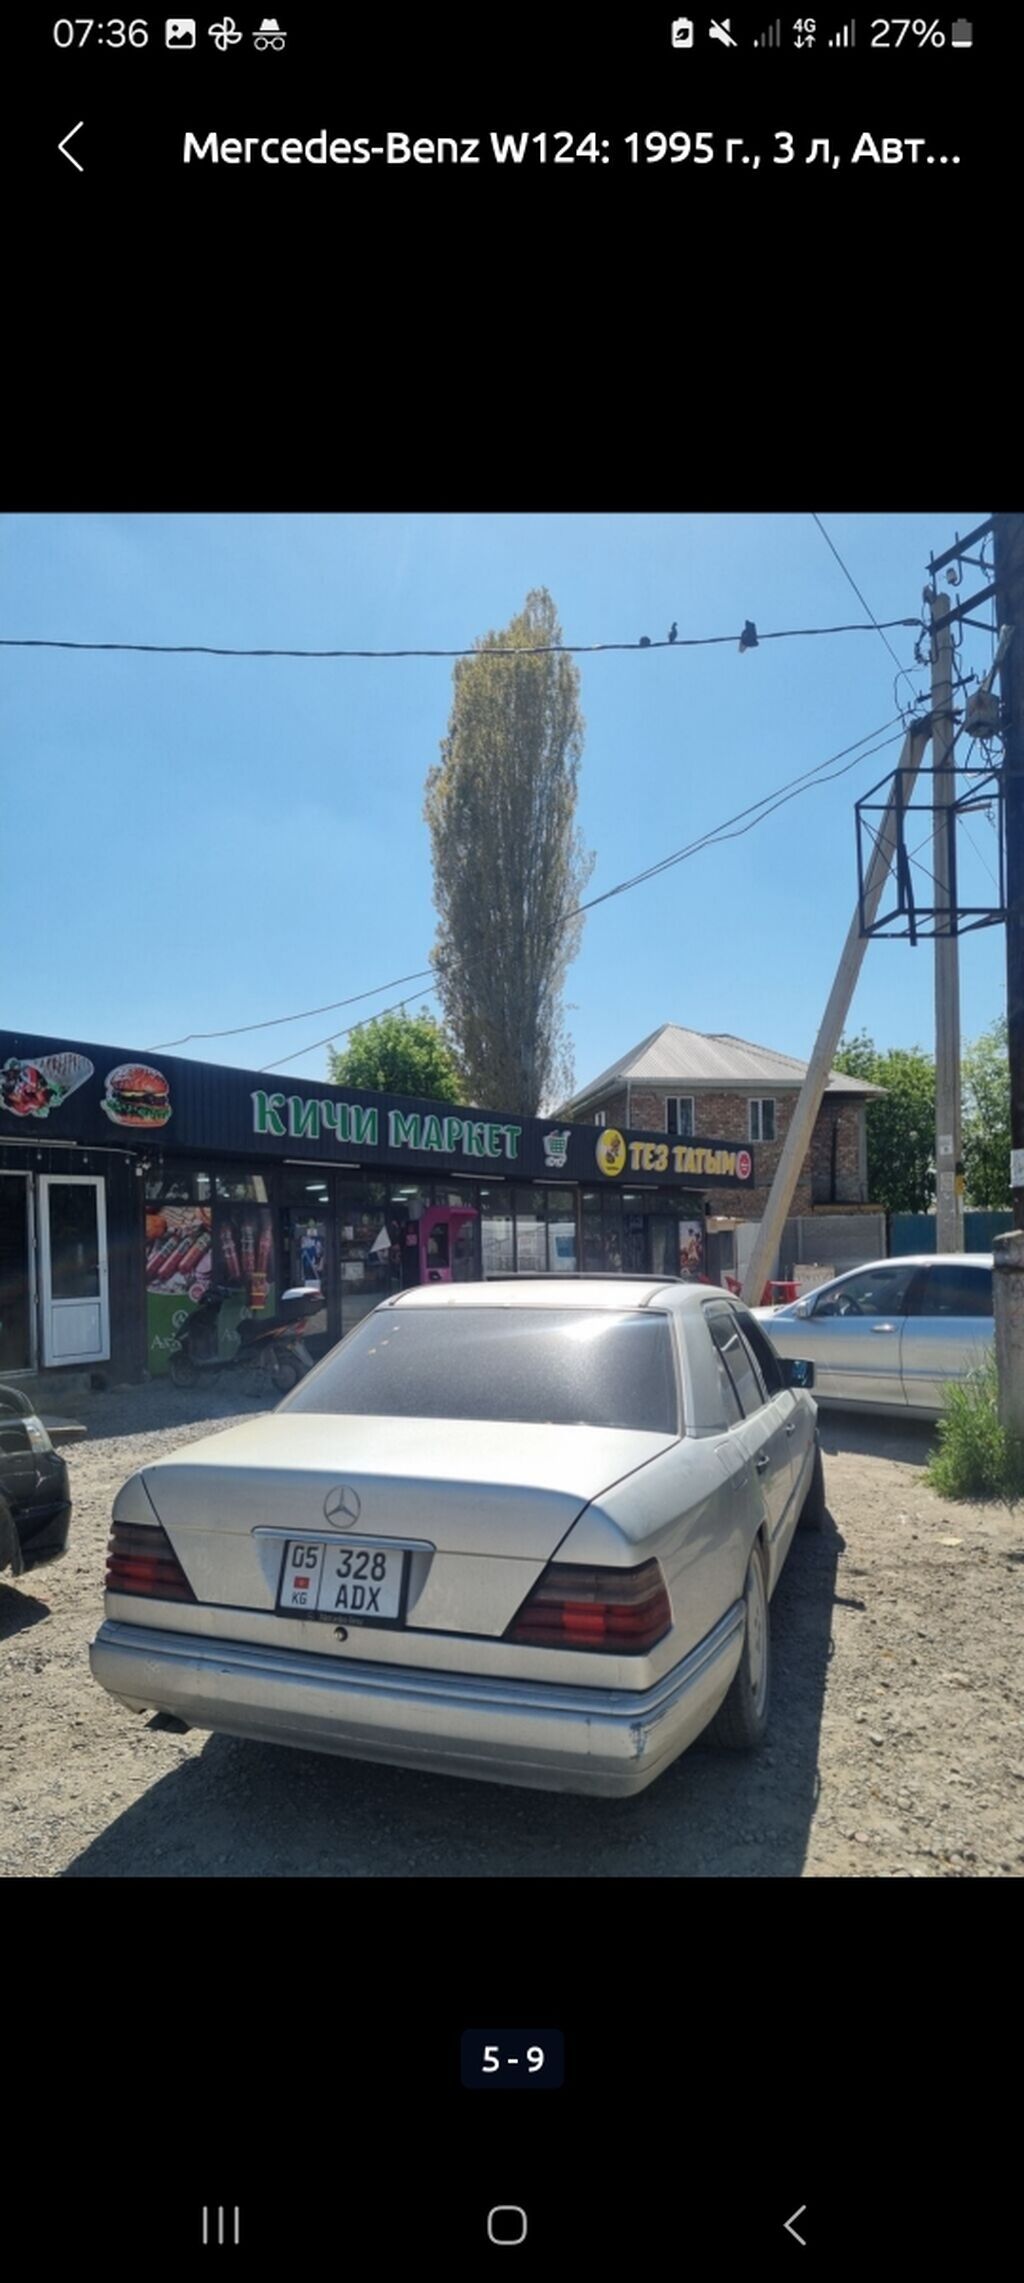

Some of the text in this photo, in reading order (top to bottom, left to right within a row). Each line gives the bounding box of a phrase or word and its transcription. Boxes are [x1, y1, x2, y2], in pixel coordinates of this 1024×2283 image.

[251, 1089, 522, 1159] КИЧИ МАРКЕТ
[628, 1141, 737, 1177] ТЕЗ ТАТЫМ
[291, 1544, 387, 1582] 05 328
[291, 1591, 308, 1605] KG
[334, 1584, 382, 1613] ADX
